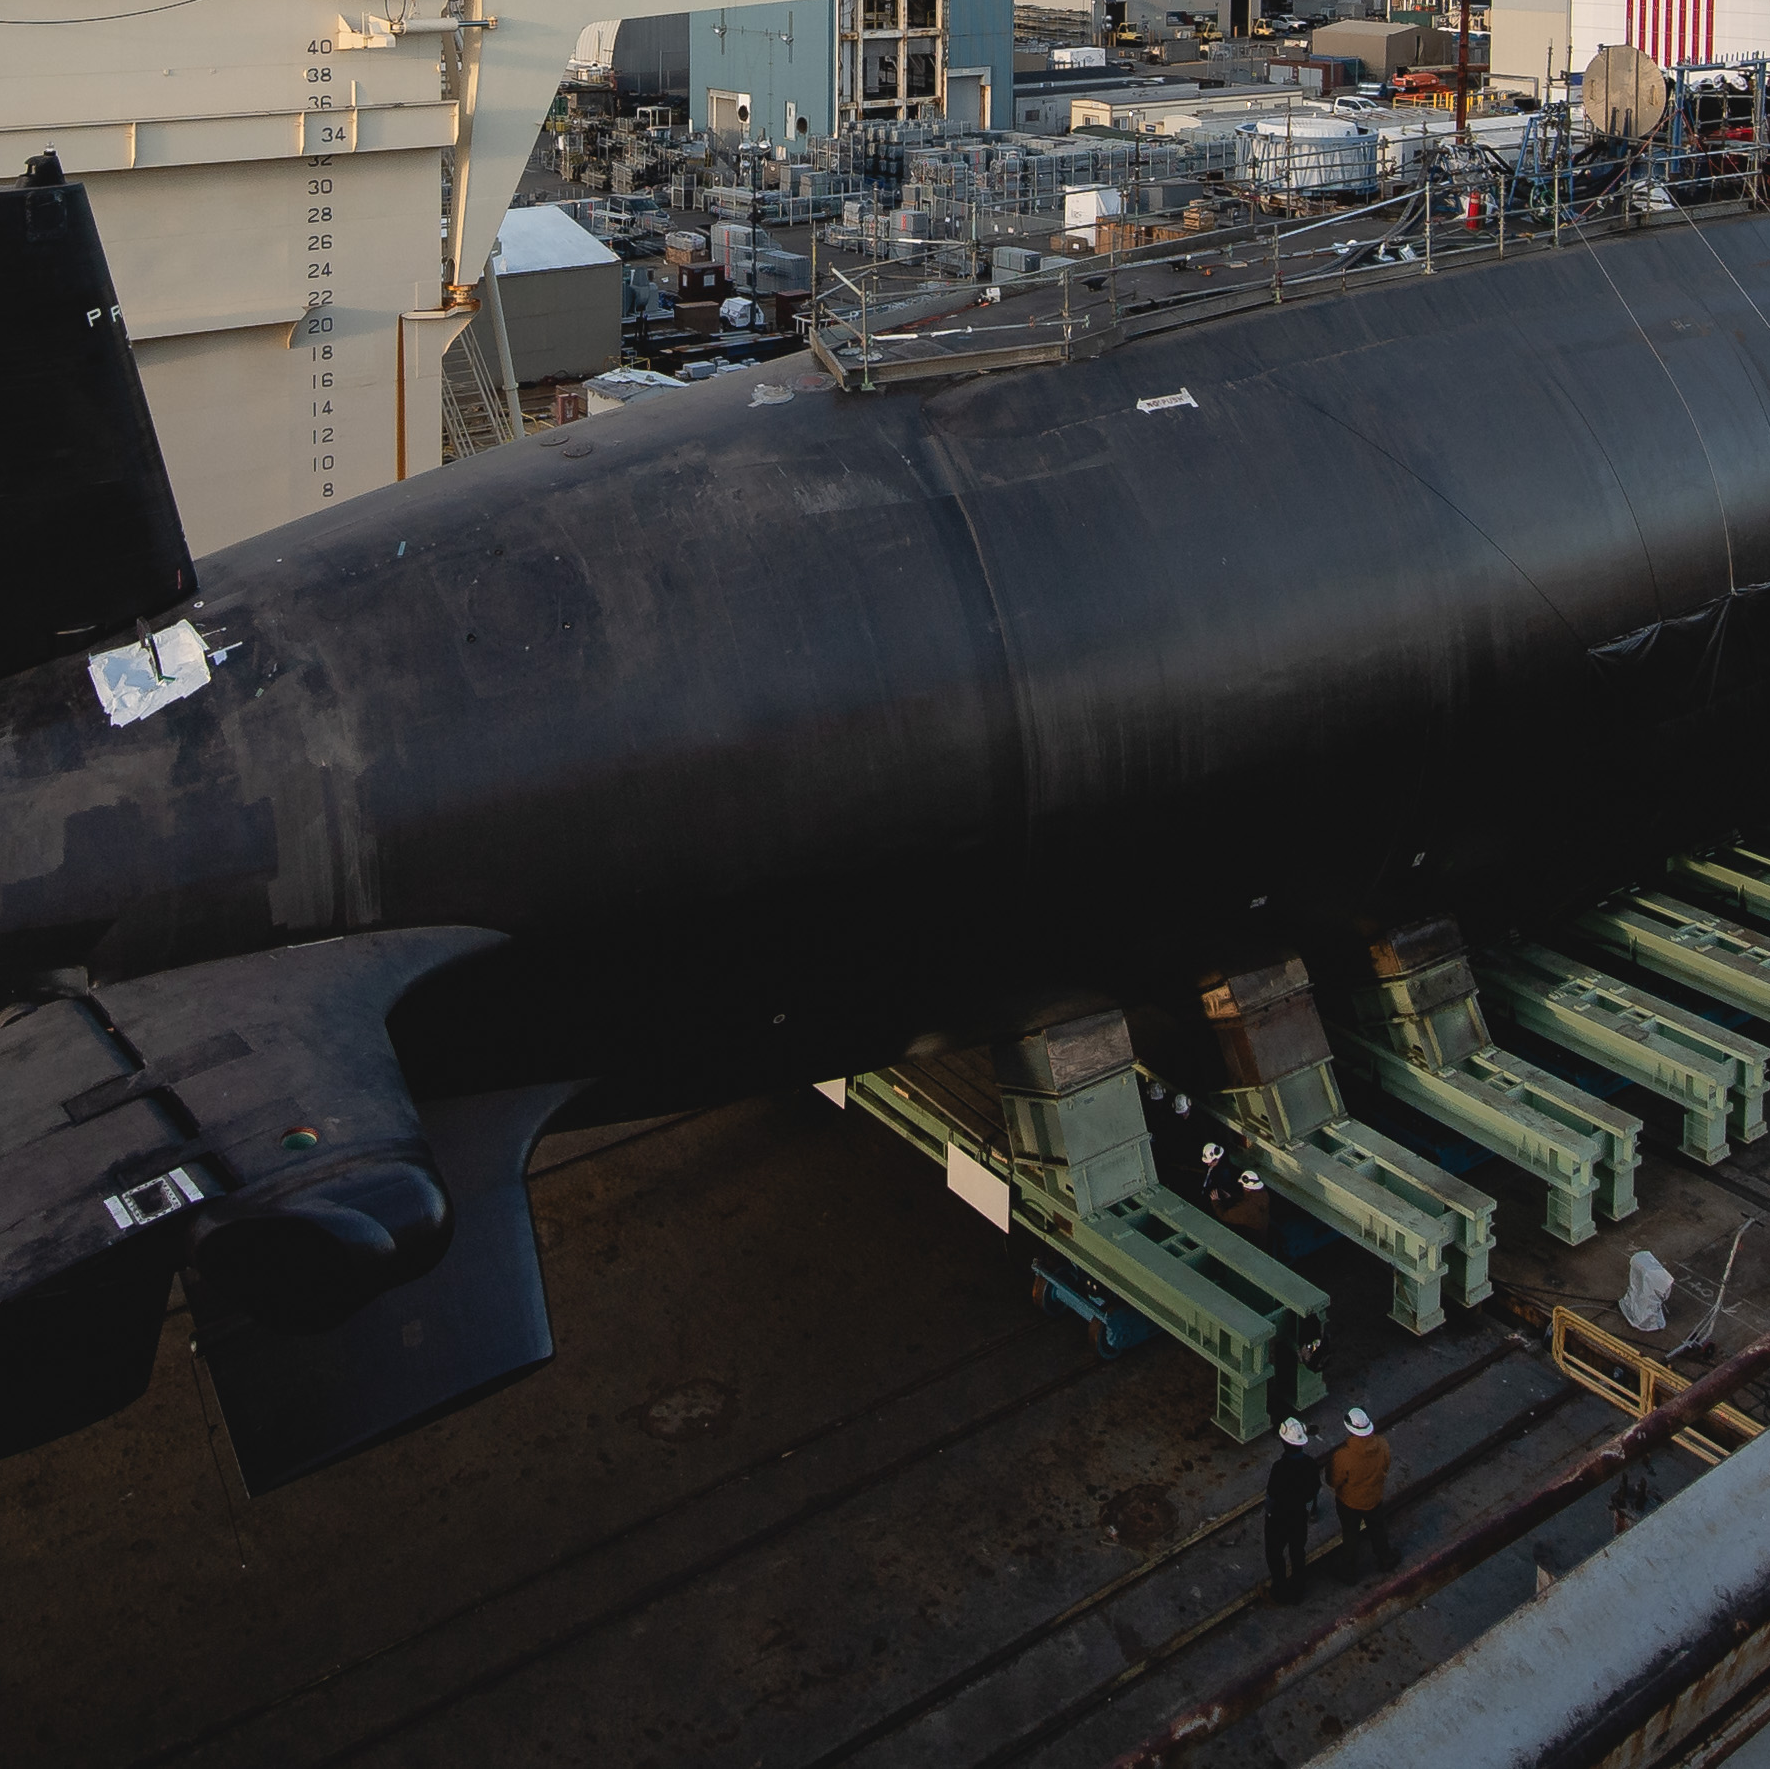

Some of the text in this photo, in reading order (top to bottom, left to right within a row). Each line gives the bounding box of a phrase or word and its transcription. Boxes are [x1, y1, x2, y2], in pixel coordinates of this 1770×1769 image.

[307, 39, 333, 55] 40
[307, 67, 332, 83] 38
[307, 95, 332, 110] 36
[321, 126, 347, 143] 34
[308, 154, 333, 168] 32
[307, 178, 333, 195] 30
[307, 206, 333, 224] 28
[307, 234, 333, 252] 26
[307, 262, 333, 279] 24
[308, 290, 334, 306] 22
[307, 317, 333, 335] 20
[312, 344, 334, 362] 18
[312, 372, 334, 390] 16
[313, 400, 334, 418] 14
[312, 427, 334, 445] 12
[313, 455, 335, 473] 10
[322, 482, 334, 498] 8
